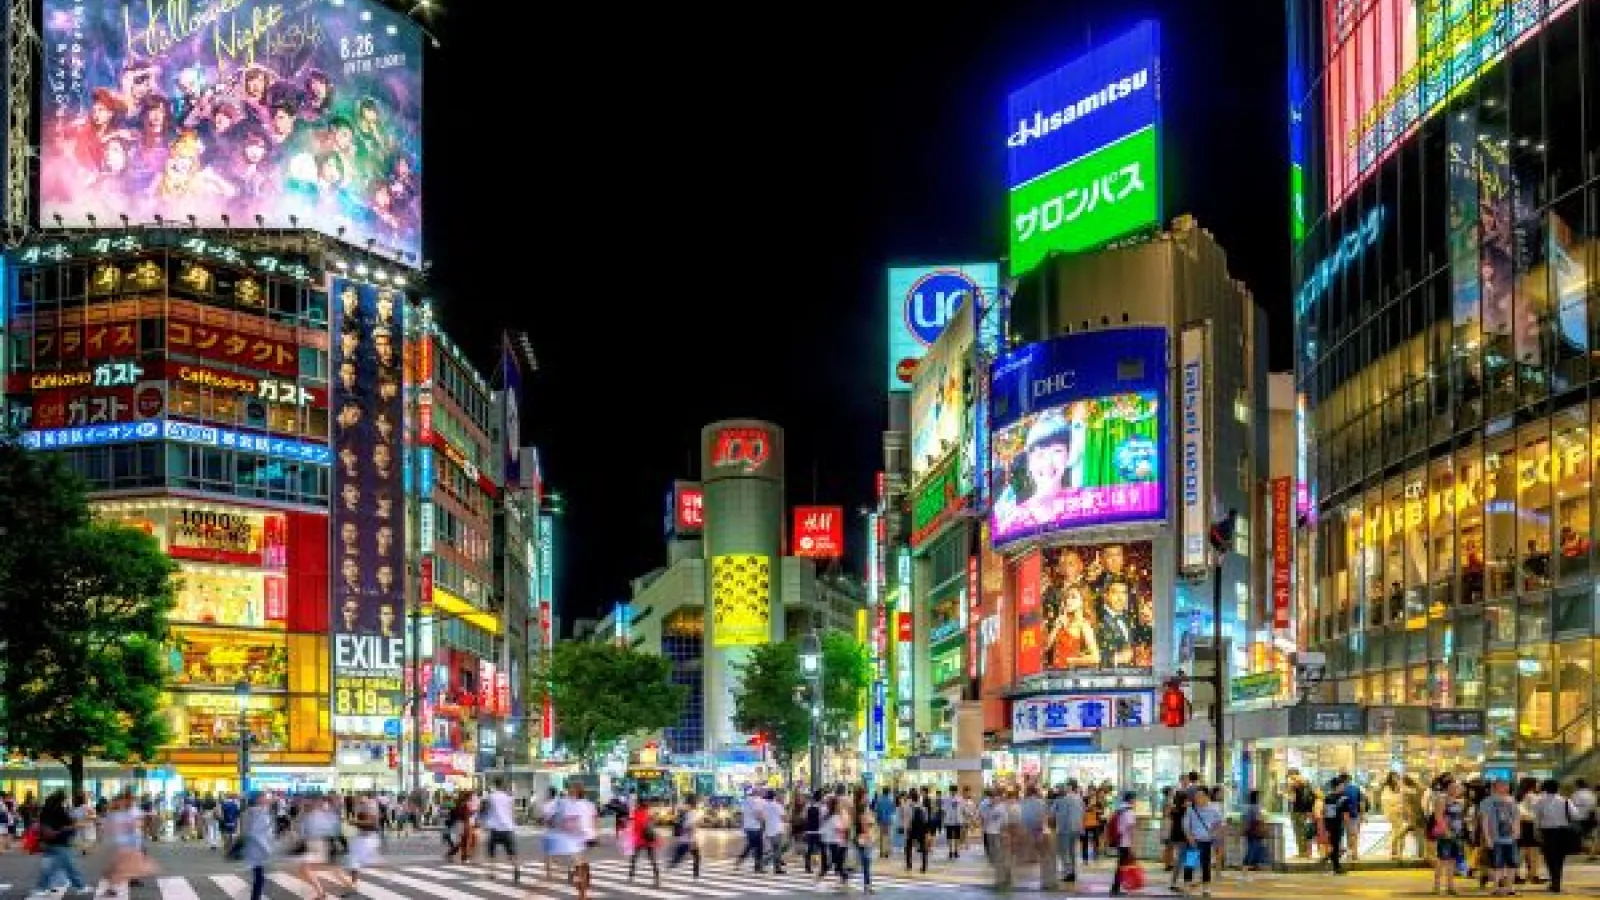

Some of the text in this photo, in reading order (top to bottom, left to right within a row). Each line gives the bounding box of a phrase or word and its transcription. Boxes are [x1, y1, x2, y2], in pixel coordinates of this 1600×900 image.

[340, 33, 375, 60] 8.26
[1014, 161, 1144, 243] サロンパス
[168, 324, 295, 366] コンタクト
[95, 363, 144, 387] ガスト
[1032, 370, 1076, 398] DHC
[258, 379, 315, 408] ガスト
[335, 633, 404, 669] EXILE
